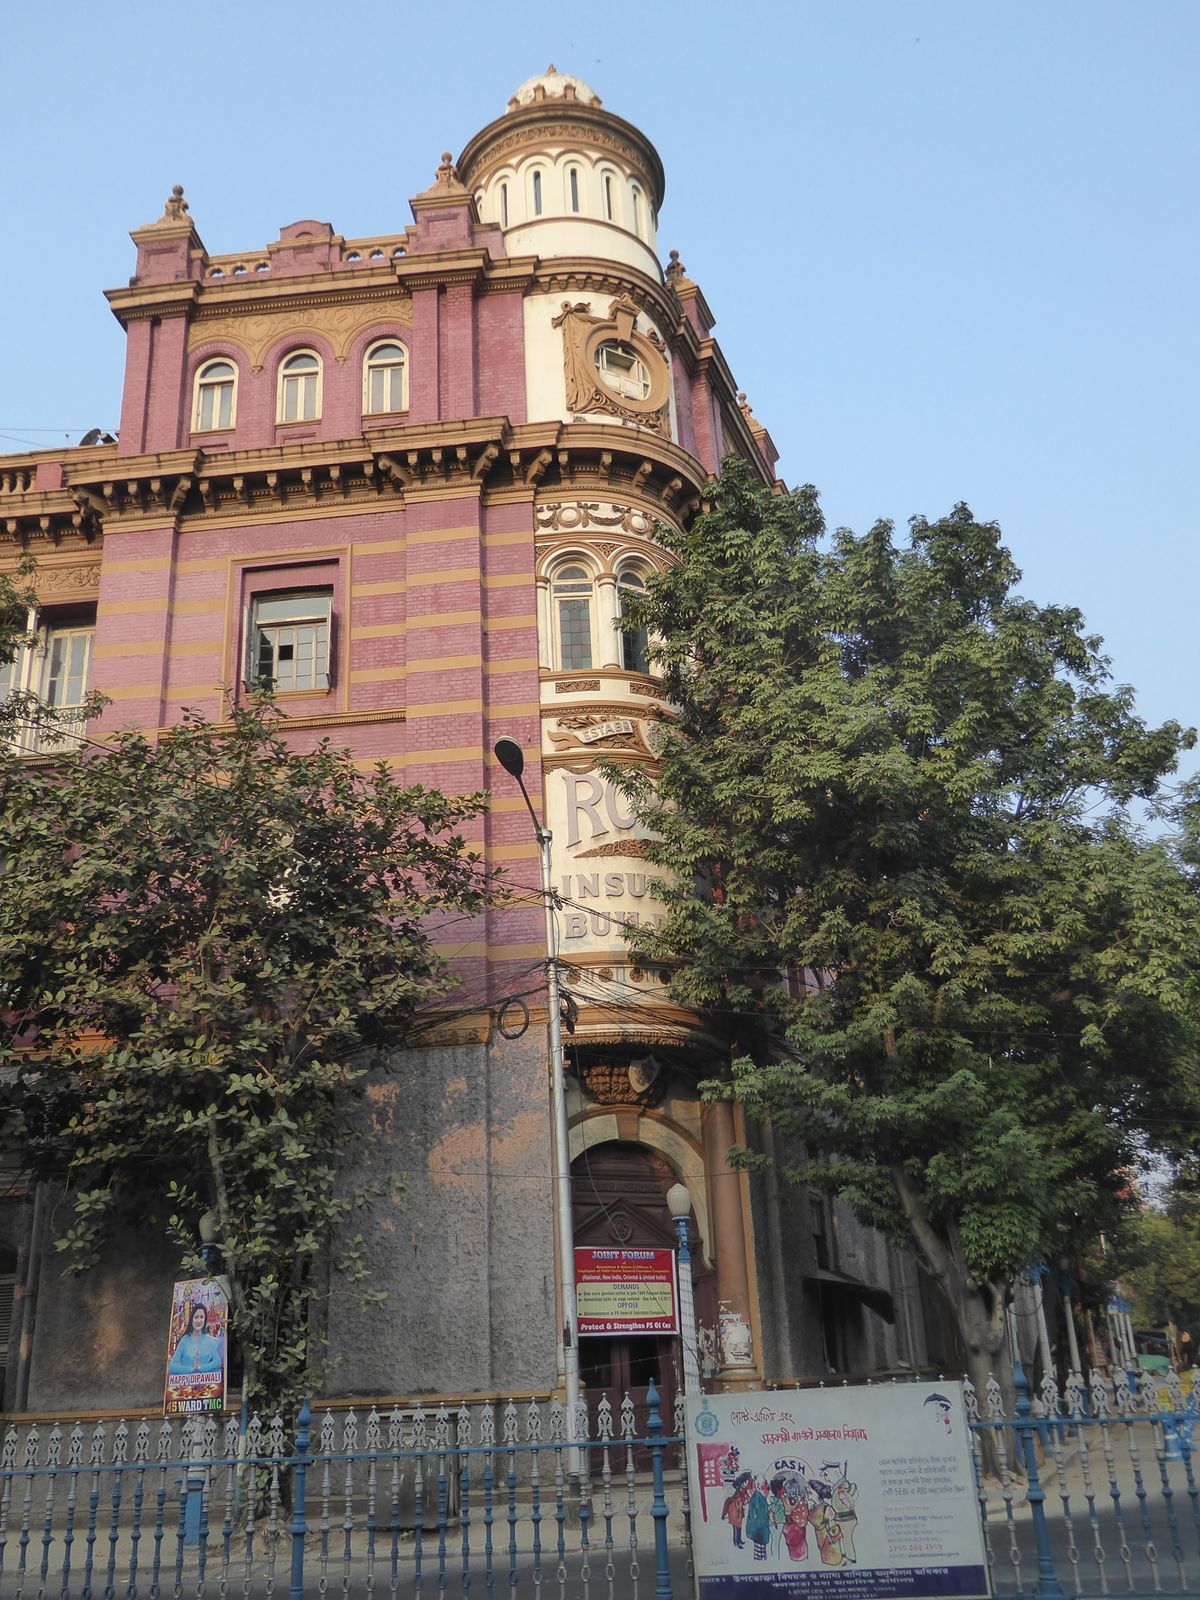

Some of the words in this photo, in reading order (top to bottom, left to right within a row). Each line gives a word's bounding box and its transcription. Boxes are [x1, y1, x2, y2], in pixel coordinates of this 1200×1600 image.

[592, 1250, 620, 1260] JOINT
[621, 1251, 655, 1260] FORUM
[580, 1323, 605, 1331] Protect
[613, 1322, 645, 1331] Strengthen
[169, 1374, 190, 1386] HAPPY
[190, 1371, 221, 1384] DIPAWALI
[166, 1401, 177, 1413] 45
[177, 1400, 202, 1412] WARD
[202, 1398, 221, 1410] TMC
[774, 1460, 805, 1476] CASH
